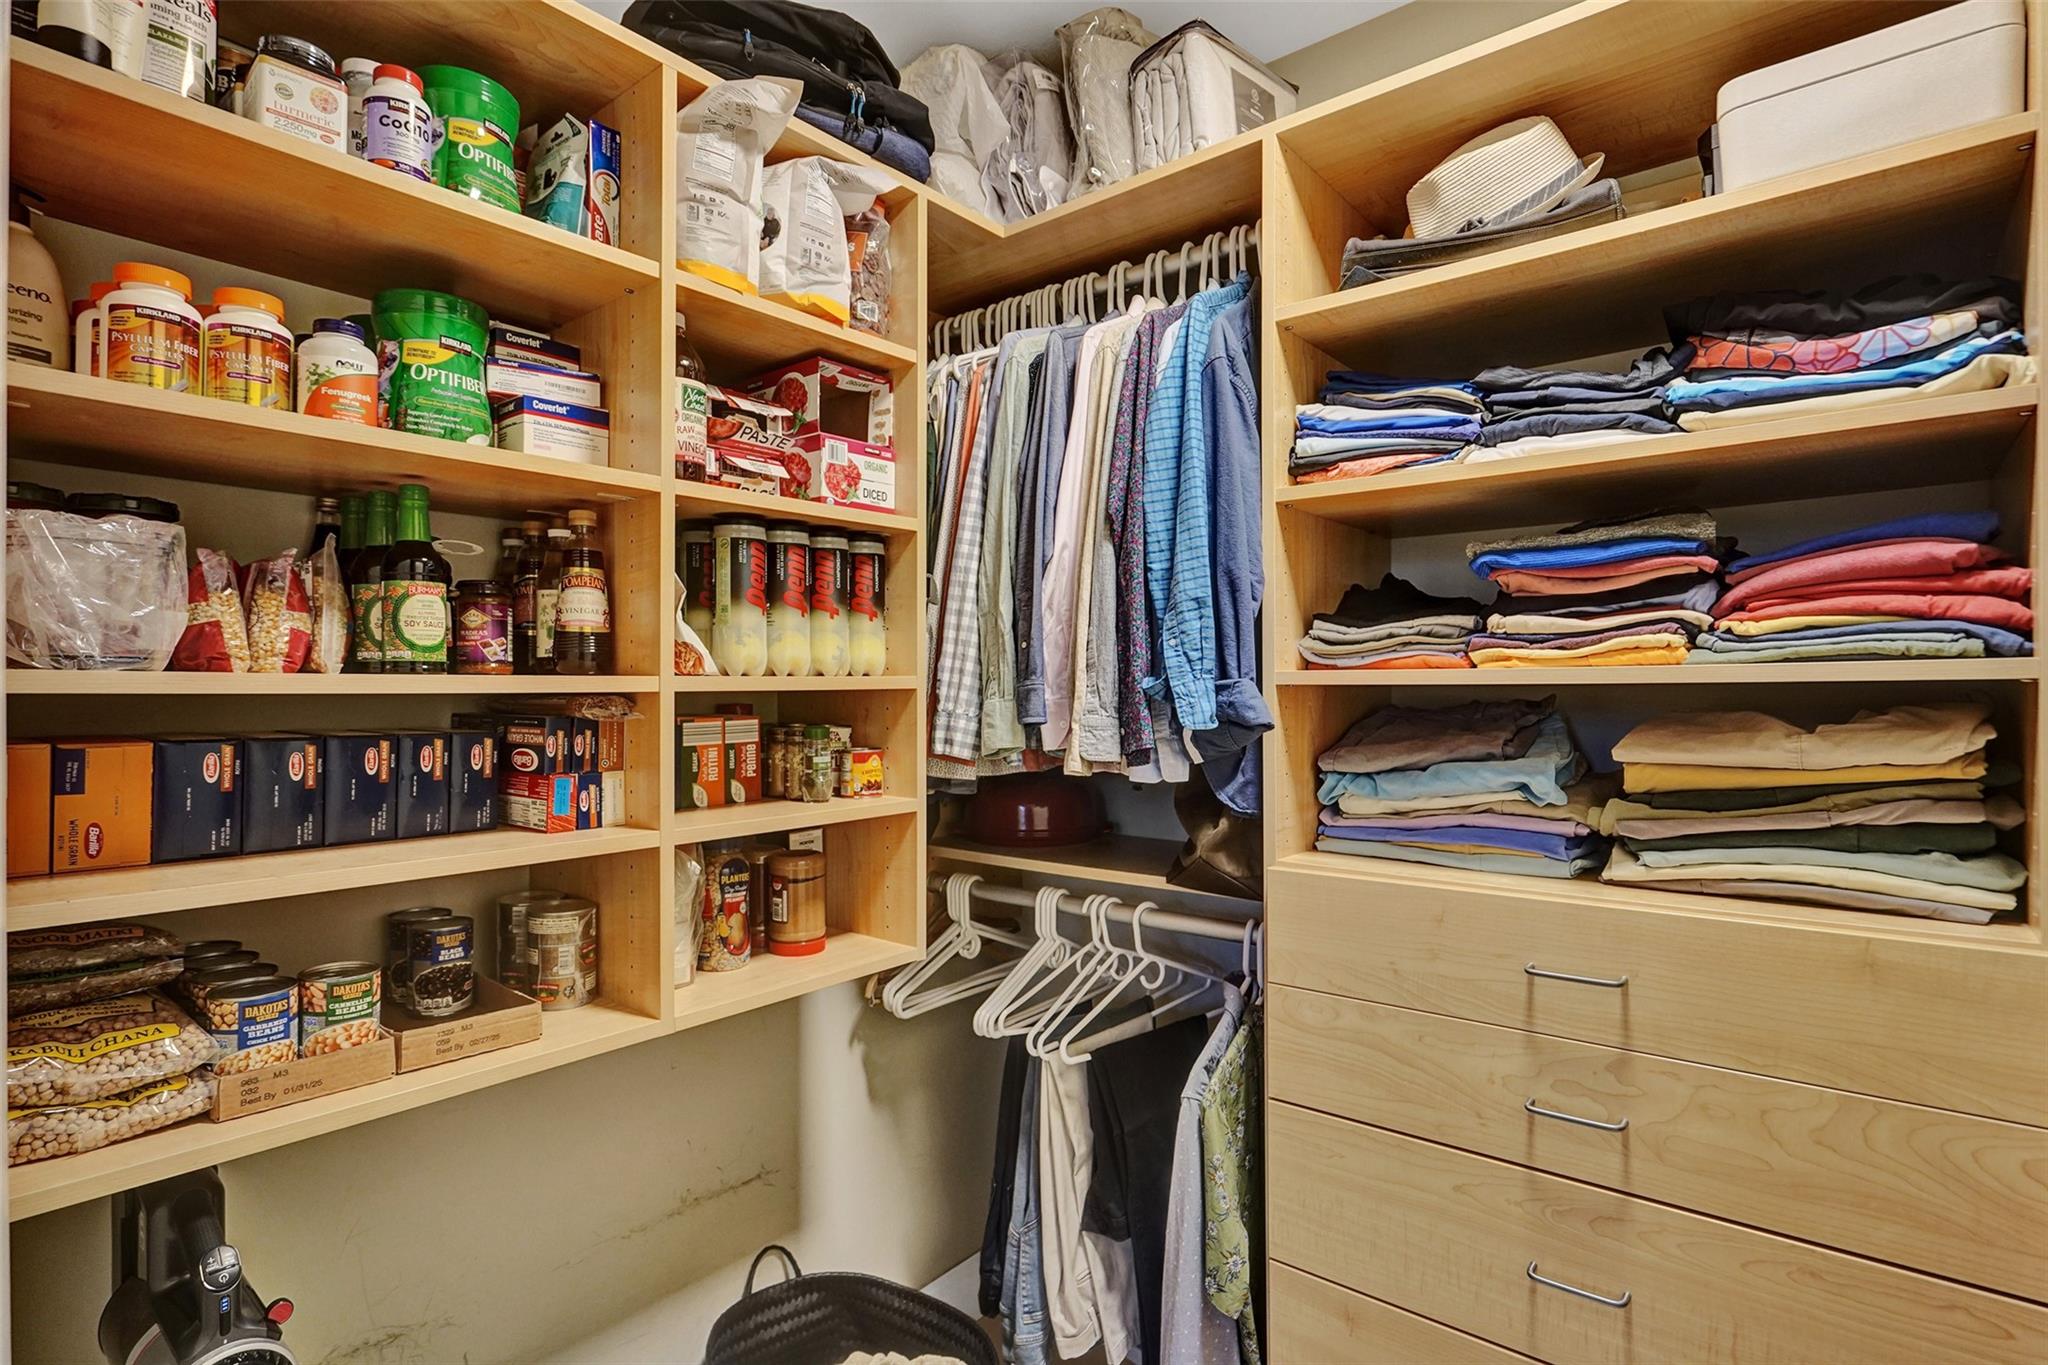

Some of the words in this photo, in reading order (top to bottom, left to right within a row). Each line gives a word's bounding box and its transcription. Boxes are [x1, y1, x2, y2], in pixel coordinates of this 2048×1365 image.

[167, 0, 211, 23] eal's
[184, 13, 207, 33] Bath
[602, 177, 611, 206] Total
[136, 307, 181, 322] KIRKLAND
[231, 325, 273, 340] KIRKLAND
[506, 332, 541, 349] Coverlet
[174, 340, 199, 358] FIBER
[265, 356, 289, 373] FIBER
[321, 386, 372, 404] Fenugreek
[532, 399, 569, 415] Coverlet
[676, 425, 695, 434] RAW
[864, 461, 888, 474] ORGANIC
[863, 488, 888, 502] DICED
[562, 575, 606, 589] POMPEIAN
[744, 541, 767, 616] penn
[783, 544, 808, 618] penn
[812, 550, 840, 620] penn
[851, 554, 878, 622] penn
[404, 620, 421, 628] SOY
[424, 620, 444, 629] SAUCE
[524, 733, 544, 743] WHOLE
[223, 746, 231, 766] GRAIN
[307, 746, 315, 765] GRAIN
[513, 754, 532, 766] Barilla
[708, 747, 719, 781] ROTINI
[207, 754, 216, 777] Barilla
[223, 766, 231, 789] WHOLE
[307, 765, 315, 786] WHOLE
[68, 819, 79, 843] WHOLE
[89, 826, 100, 857] Barilla
[68, 844, 79, 866] GRAIN
[9, 934, 70, 945] ASOOR
[76, 928, 134, 944] MATKI
[438, 951, 465, 962] BEANS
[440, 946, 464, 955] BLACK
[335, 1003, 368, 1015] BEANS
[243, 1018, 288, 1032] GARBANZO
[248, 1024, 285, 1039] BEANS
[10, 1044, 85, 1058] KABULI
[90, 1026, 165, 1051] CHANA
[247, 1037, 268, 1046] CHICK
[269, 1033, 285, 1041] PEAS
[436, 1045, 452, 1056] Best
[454, 1043, 464, 1051] By
[273, 1069, 289, 1080] M3
[240, 1096, 261, 1107] Best
[264, 1092, 277, 1101] By
